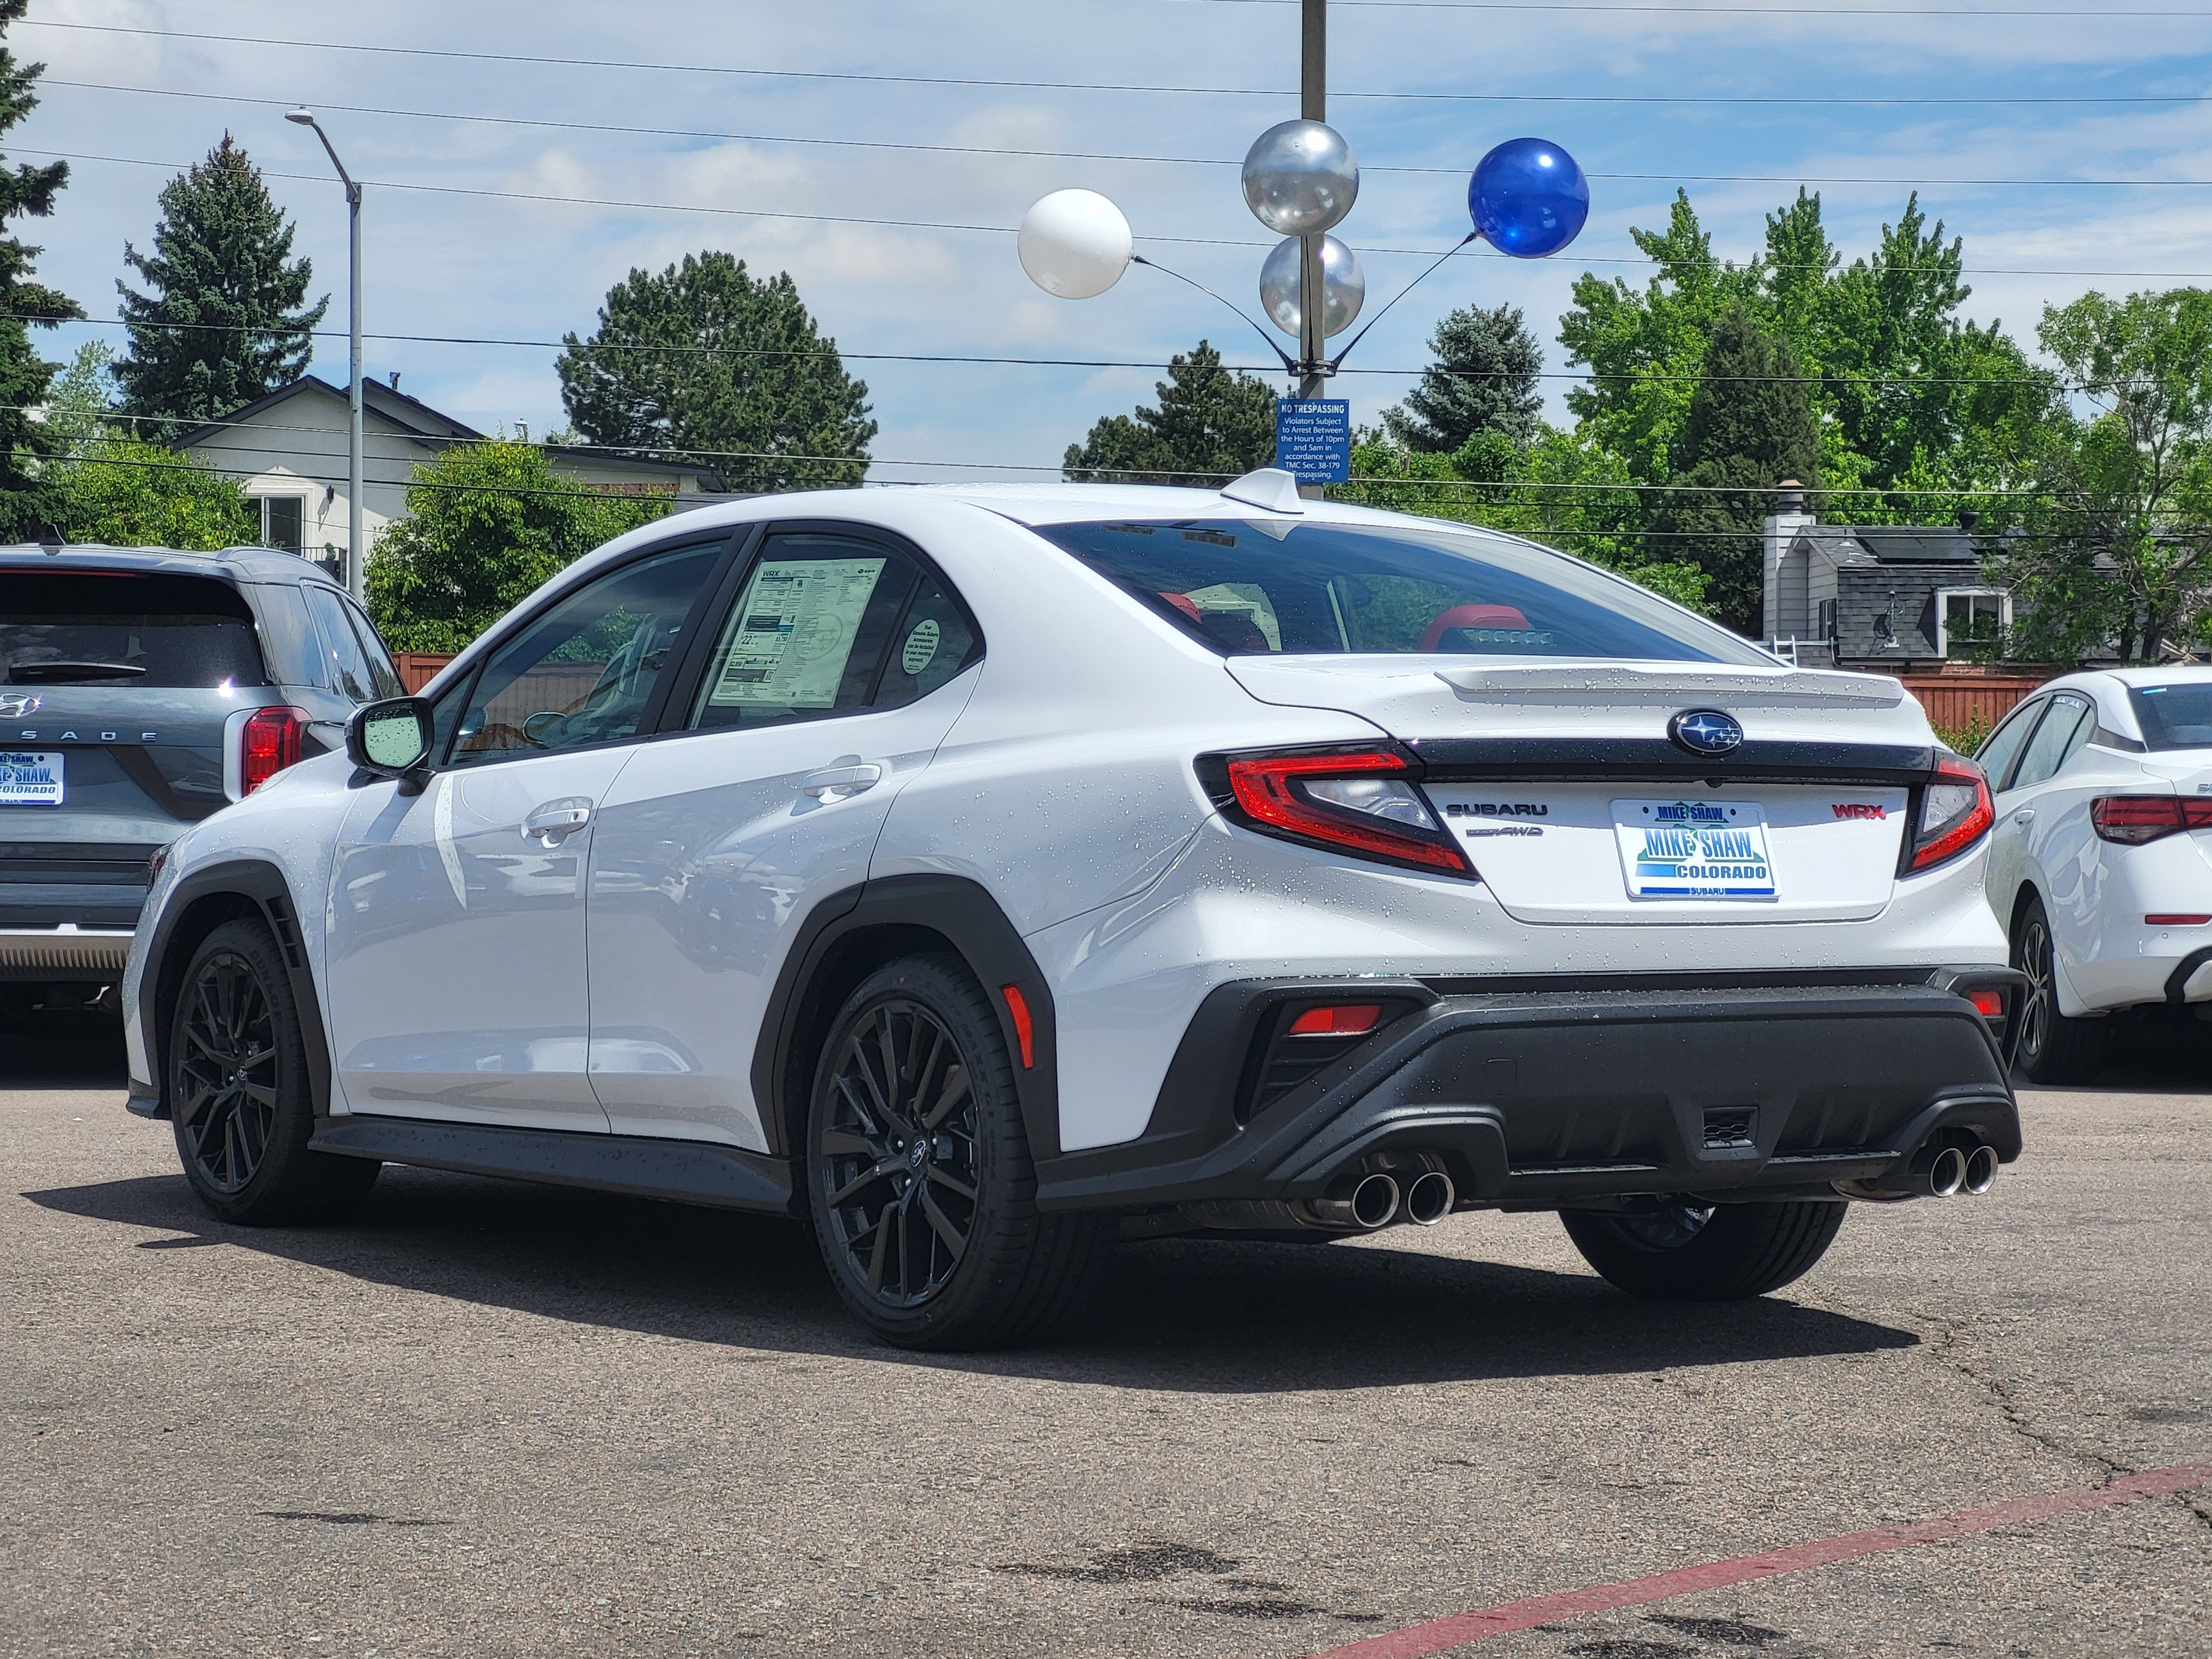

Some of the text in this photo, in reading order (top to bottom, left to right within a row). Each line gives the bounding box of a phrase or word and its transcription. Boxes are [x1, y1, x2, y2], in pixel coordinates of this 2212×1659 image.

[1281, 404, 1344, 414] NO TRESPASSING
[1316, 417, 1342, 426] Subject
[1325, 435, 1345, 444] 10pm
[20, 730, 157, 742] SADE
[15, 767, 51, 782] SHAW
[1446, 804, 1548, 817] SUBARU
[1657, 806, 1723, 821] MIKE SHAW
[1832, 804, 1887, 820] WRX
[1645, 829, 1752, 858] MIKE SHAW
[1677, 865, 1766, 879] COLORADO
[249, 948, 284, 1024] DUNLOP
